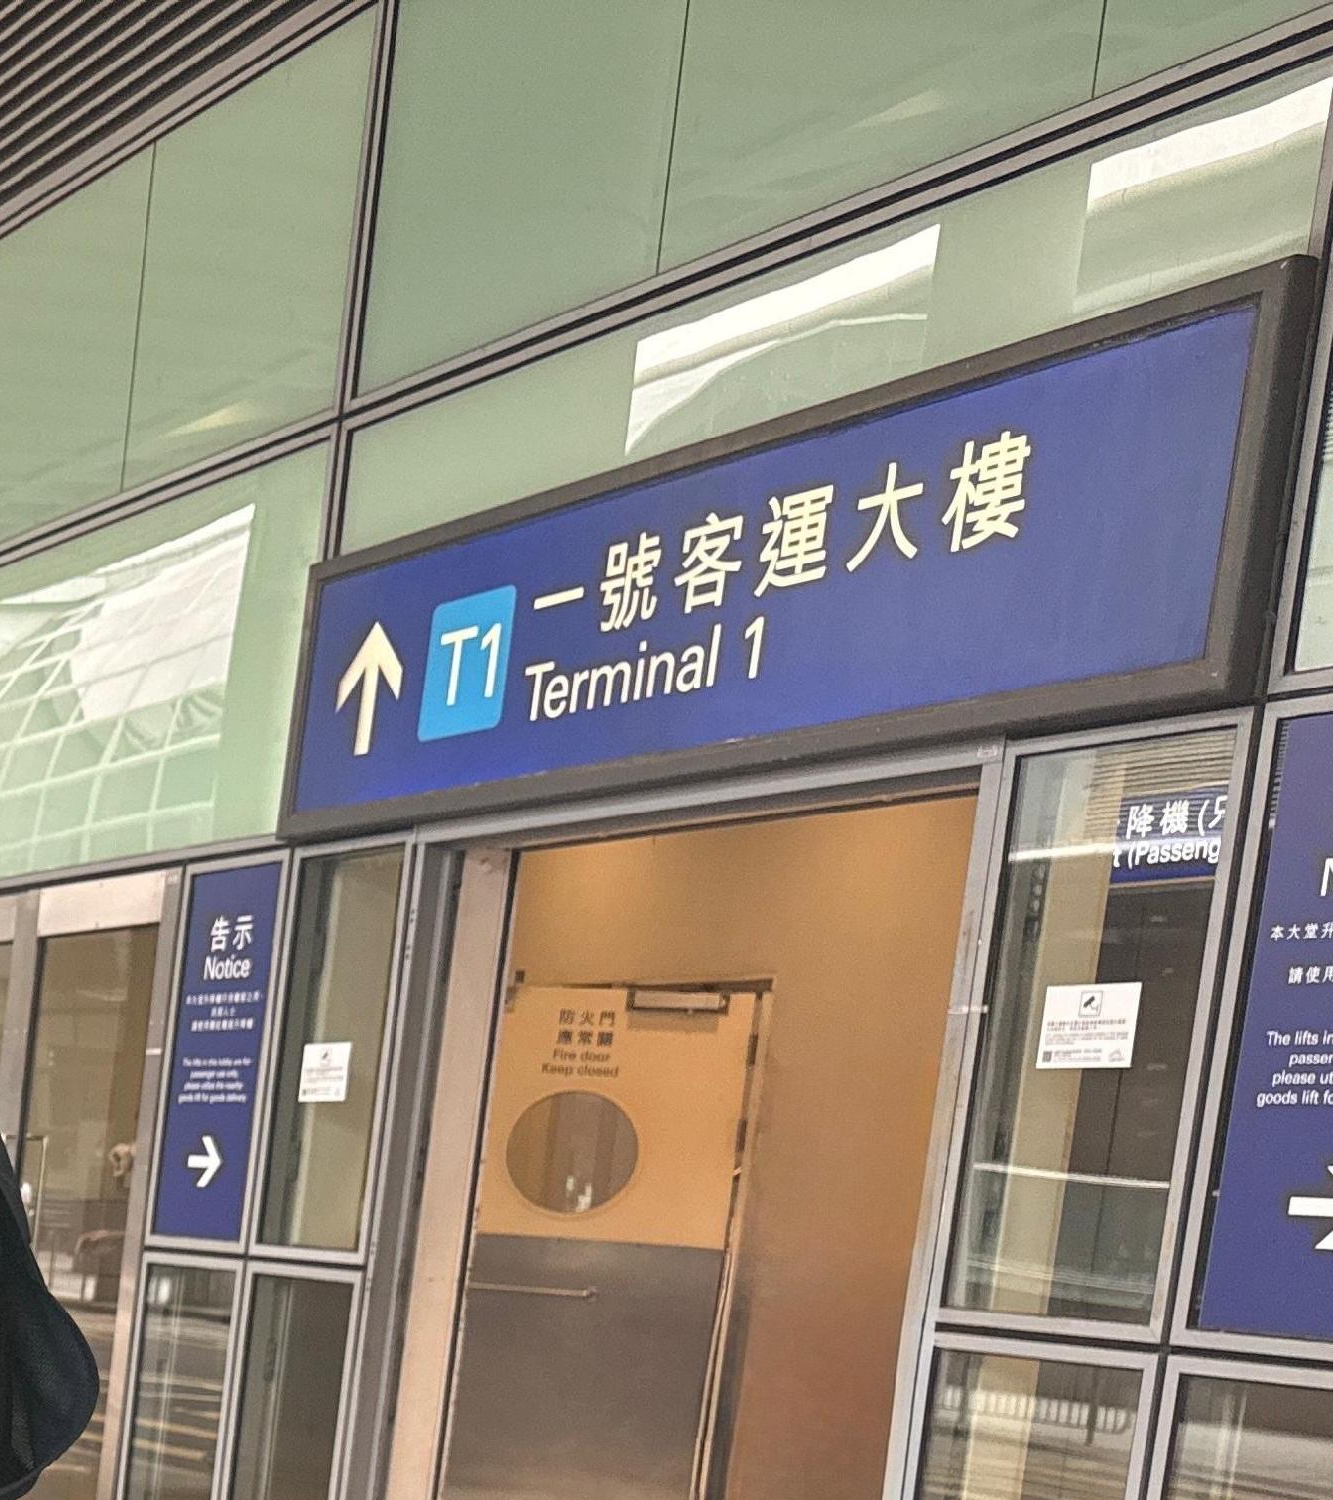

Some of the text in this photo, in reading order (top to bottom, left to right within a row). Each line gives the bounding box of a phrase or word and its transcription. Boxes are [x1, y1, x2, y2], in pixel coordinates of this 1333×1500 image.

[533, 431, 1032, 633] 一號客運大樓
[440, 622, 502, 707] T1
[525, 616, 766, 722] Terminal 1
[211, 914, 254, 952] 告示
[203, 953, 252, 981] Notice
[1266, 1030, 1291, 1046] The
[1294, 1030, 1320, 1046] lifts
[553, 1047, 611, 1062] Fire door
[541, 1062, 619, 1079] Keep closed
[1271, 1069, 1317, 1088] please
[1256, 1089, 1298, 1108] goods
[1301, 1089, 1320, 1105] lift
